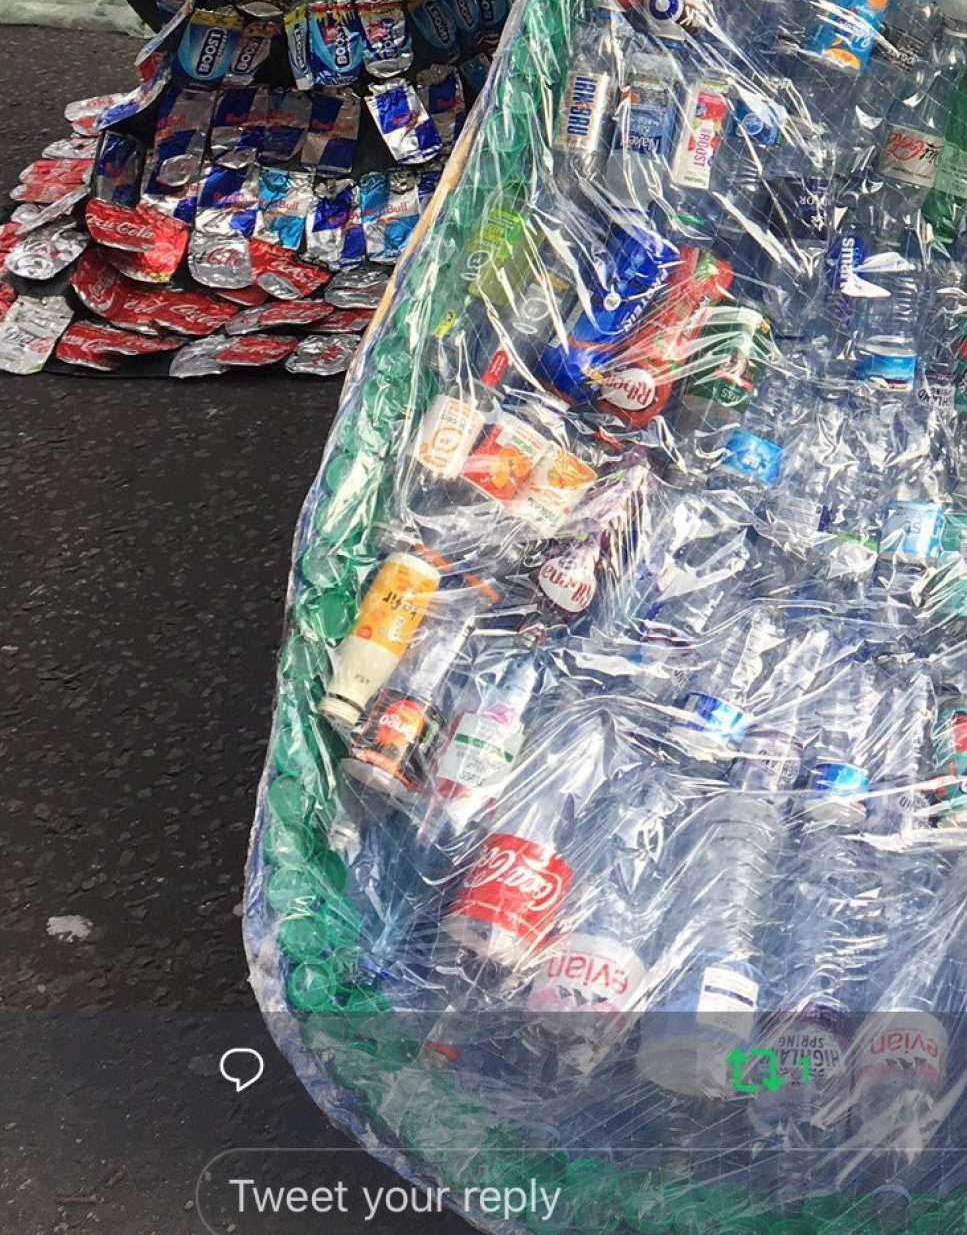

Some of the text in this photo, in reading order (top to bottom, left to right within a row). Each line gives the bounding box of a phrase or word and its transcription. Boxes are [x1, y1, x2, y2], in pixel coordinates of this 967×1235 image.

[199, 31, 223, 74] BOOST
[546, 954, 629, 995] evian
[779, 1036, 825, 1050] SPRING
[870, 1031, 938, 1058] evian
